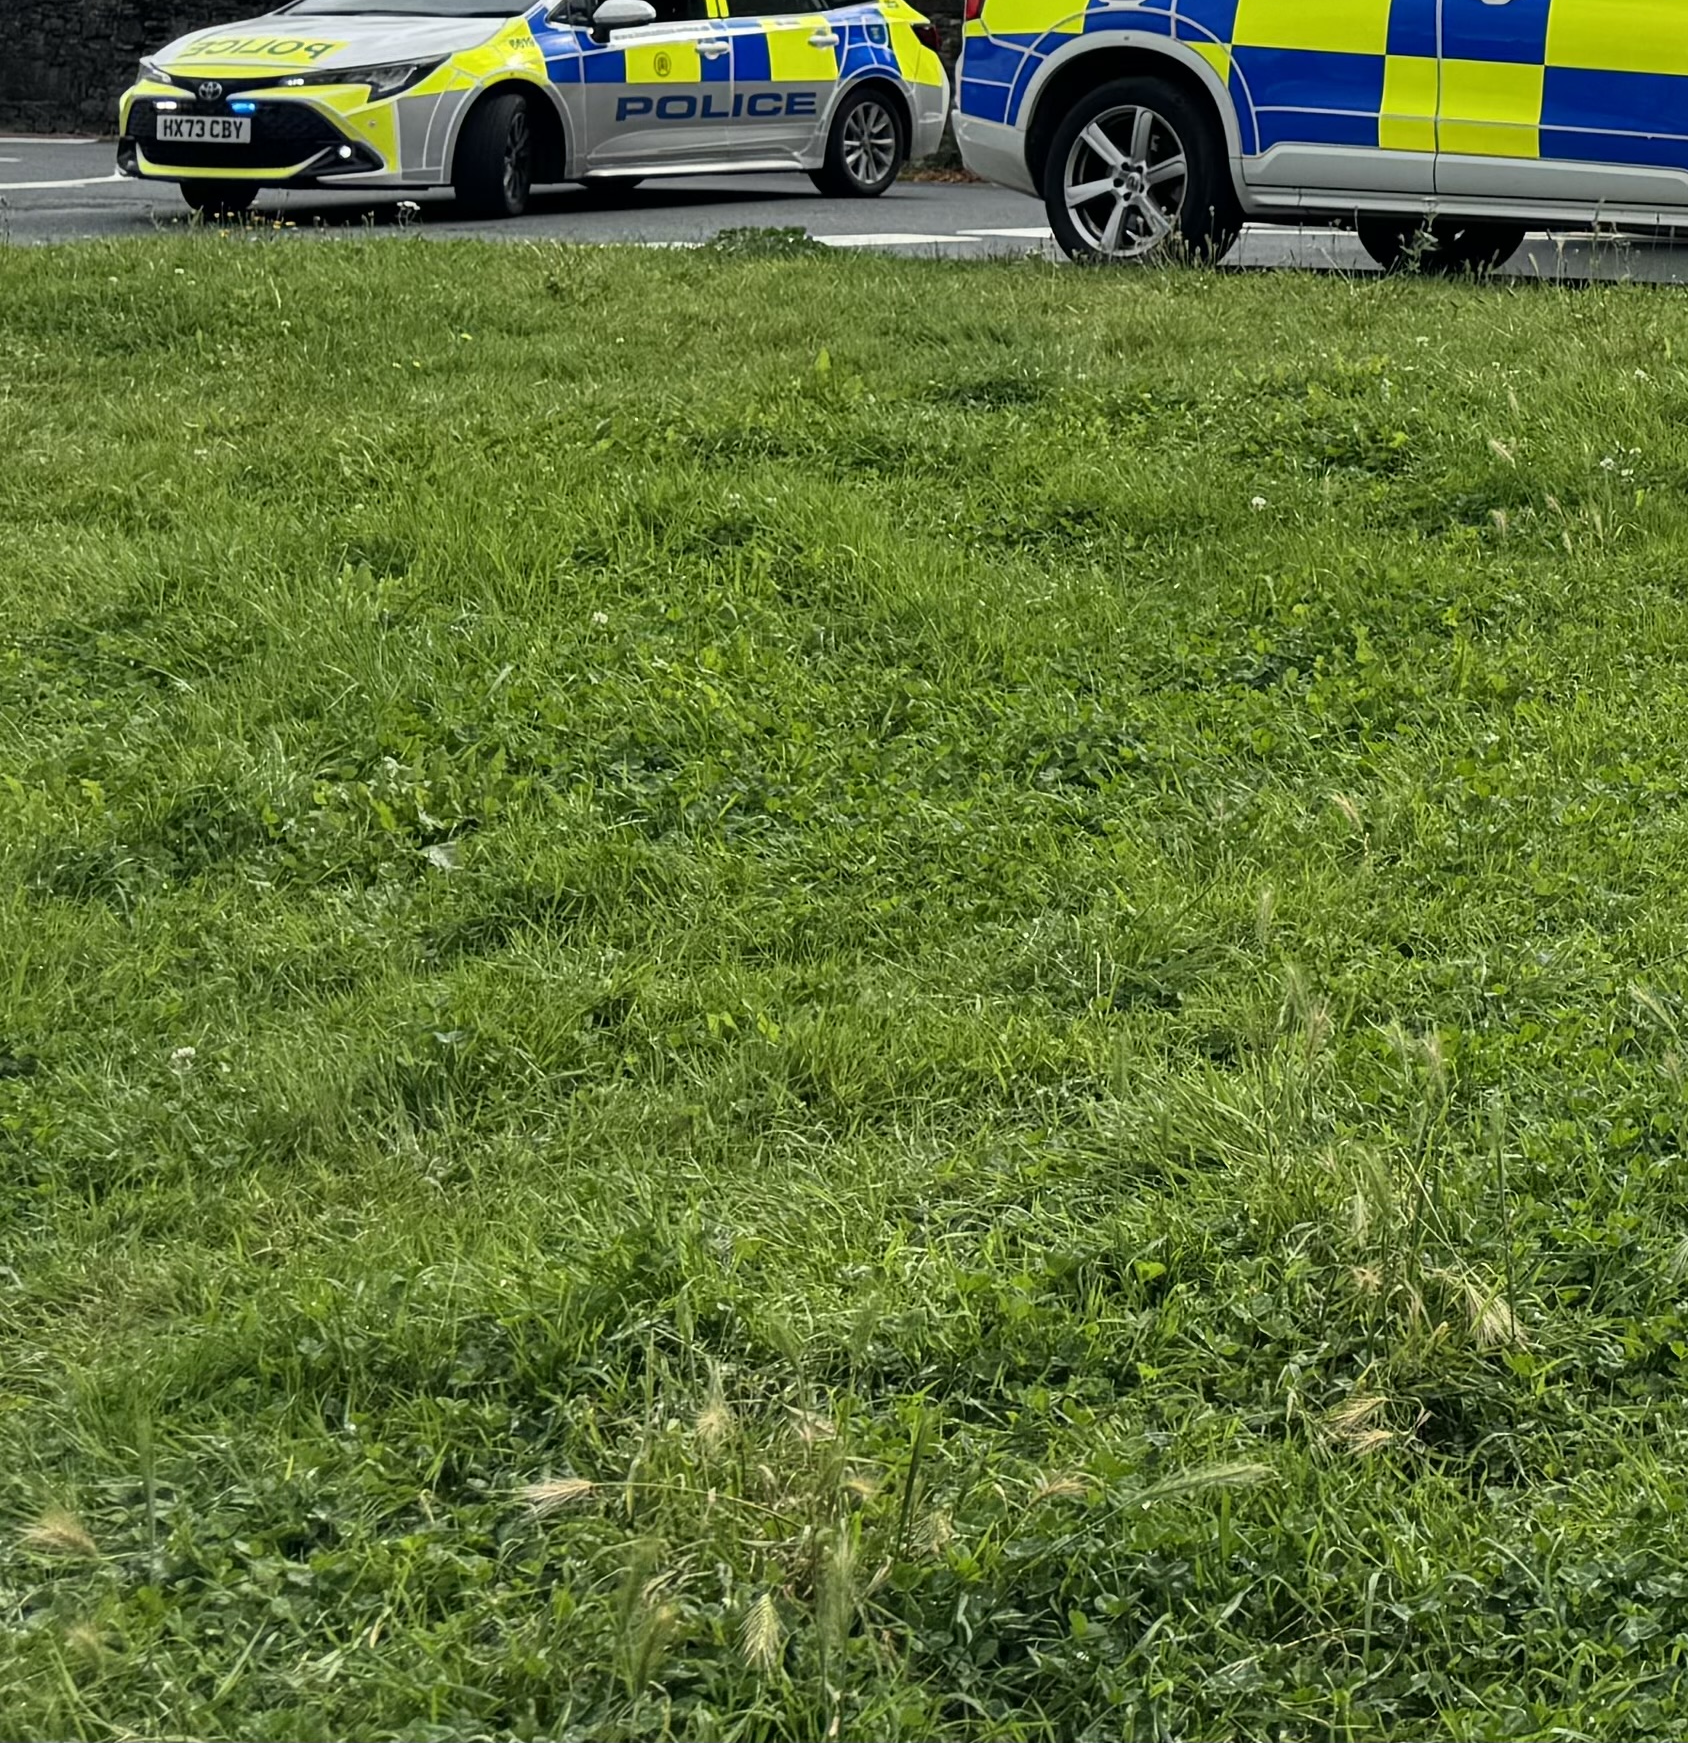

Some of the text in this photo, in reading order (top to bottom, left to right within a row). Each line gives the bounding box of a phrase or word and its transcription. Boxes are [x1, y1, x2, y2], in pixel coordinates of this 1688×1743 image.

[615, 91, 817, 122] POLICE
[163, 118, 244, 140] HX73 CBY
